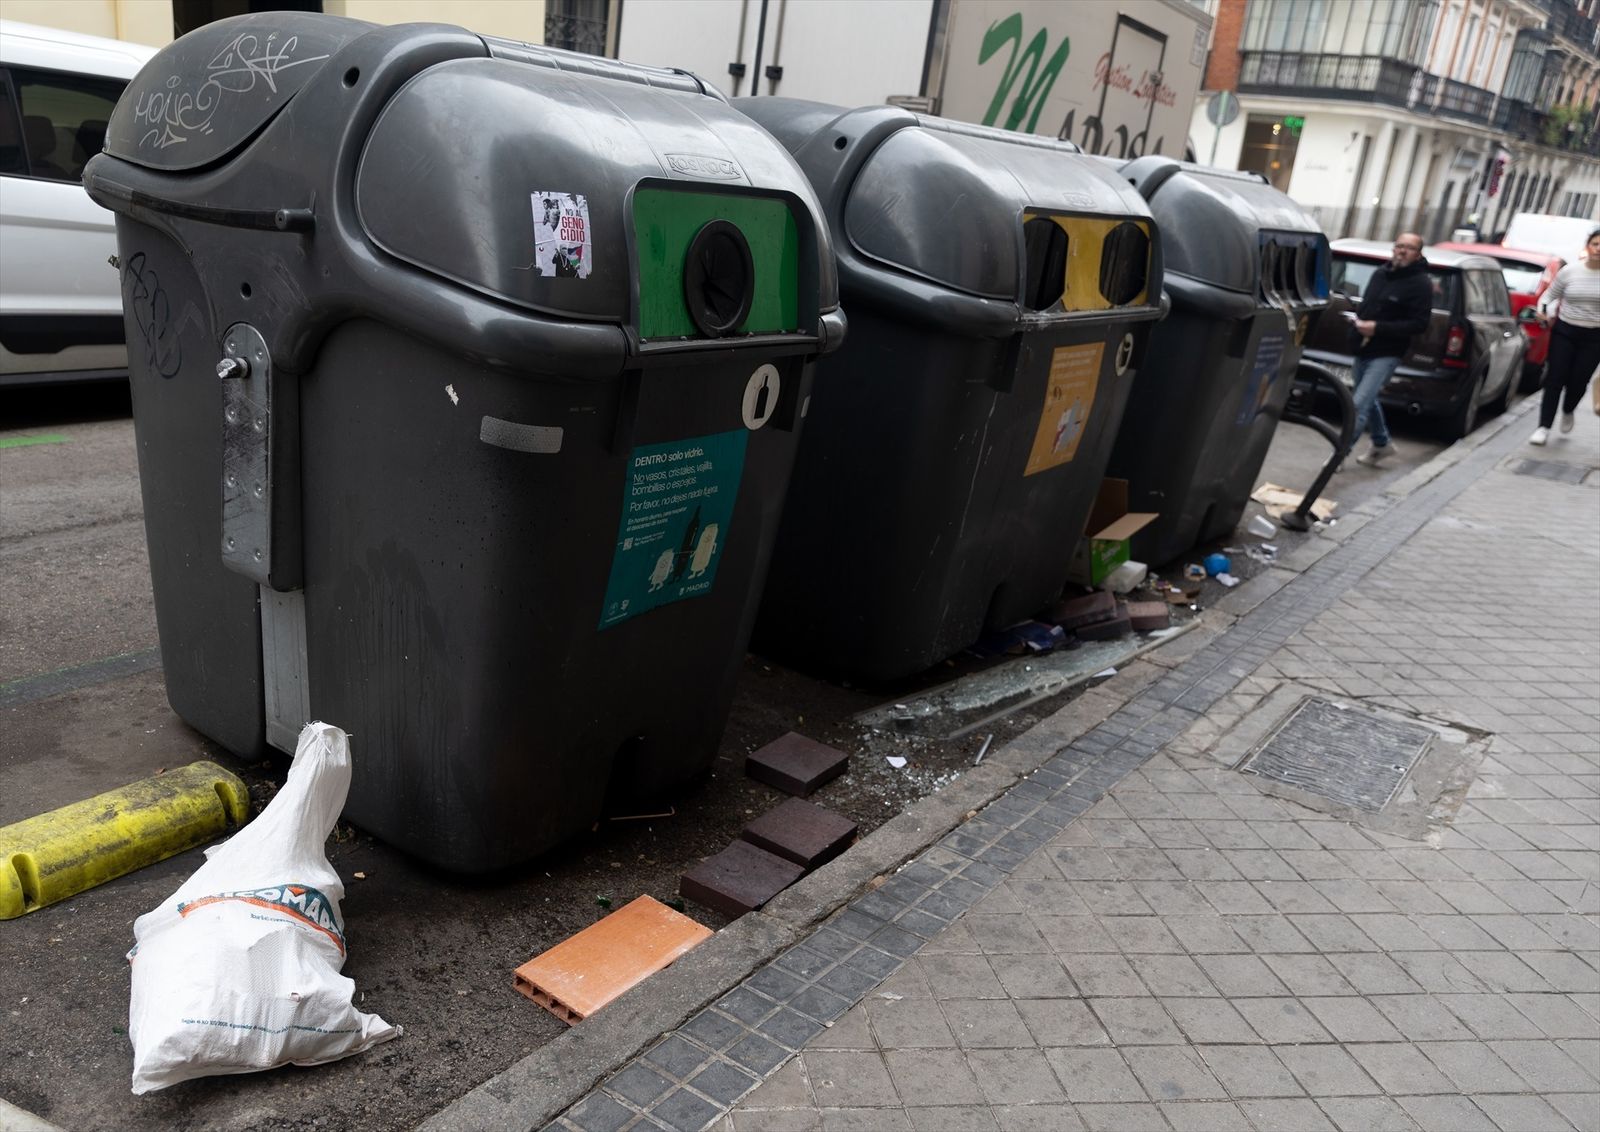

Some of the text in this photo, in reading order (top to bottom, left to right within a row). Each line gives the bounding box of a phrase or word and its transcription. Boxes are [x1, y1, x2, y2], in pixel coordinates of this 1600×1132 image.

[565, 208, 574, 217] NO
[561, 216, 584, 230] GENO
[560, 228, 585, 243] CIDIO
[635, 447, 704, 468] DENTRO solo vidrio.
[633, 473, 645, 484] No
[632, 482, 666, 496] bombillas
[666, 482, 672, 490] o
[630, 502, 643, 513] Por
[661, 497, 670, 506] no
[687, 488, 703, 499] nada
[686, 581, 710, 593] MADRID
